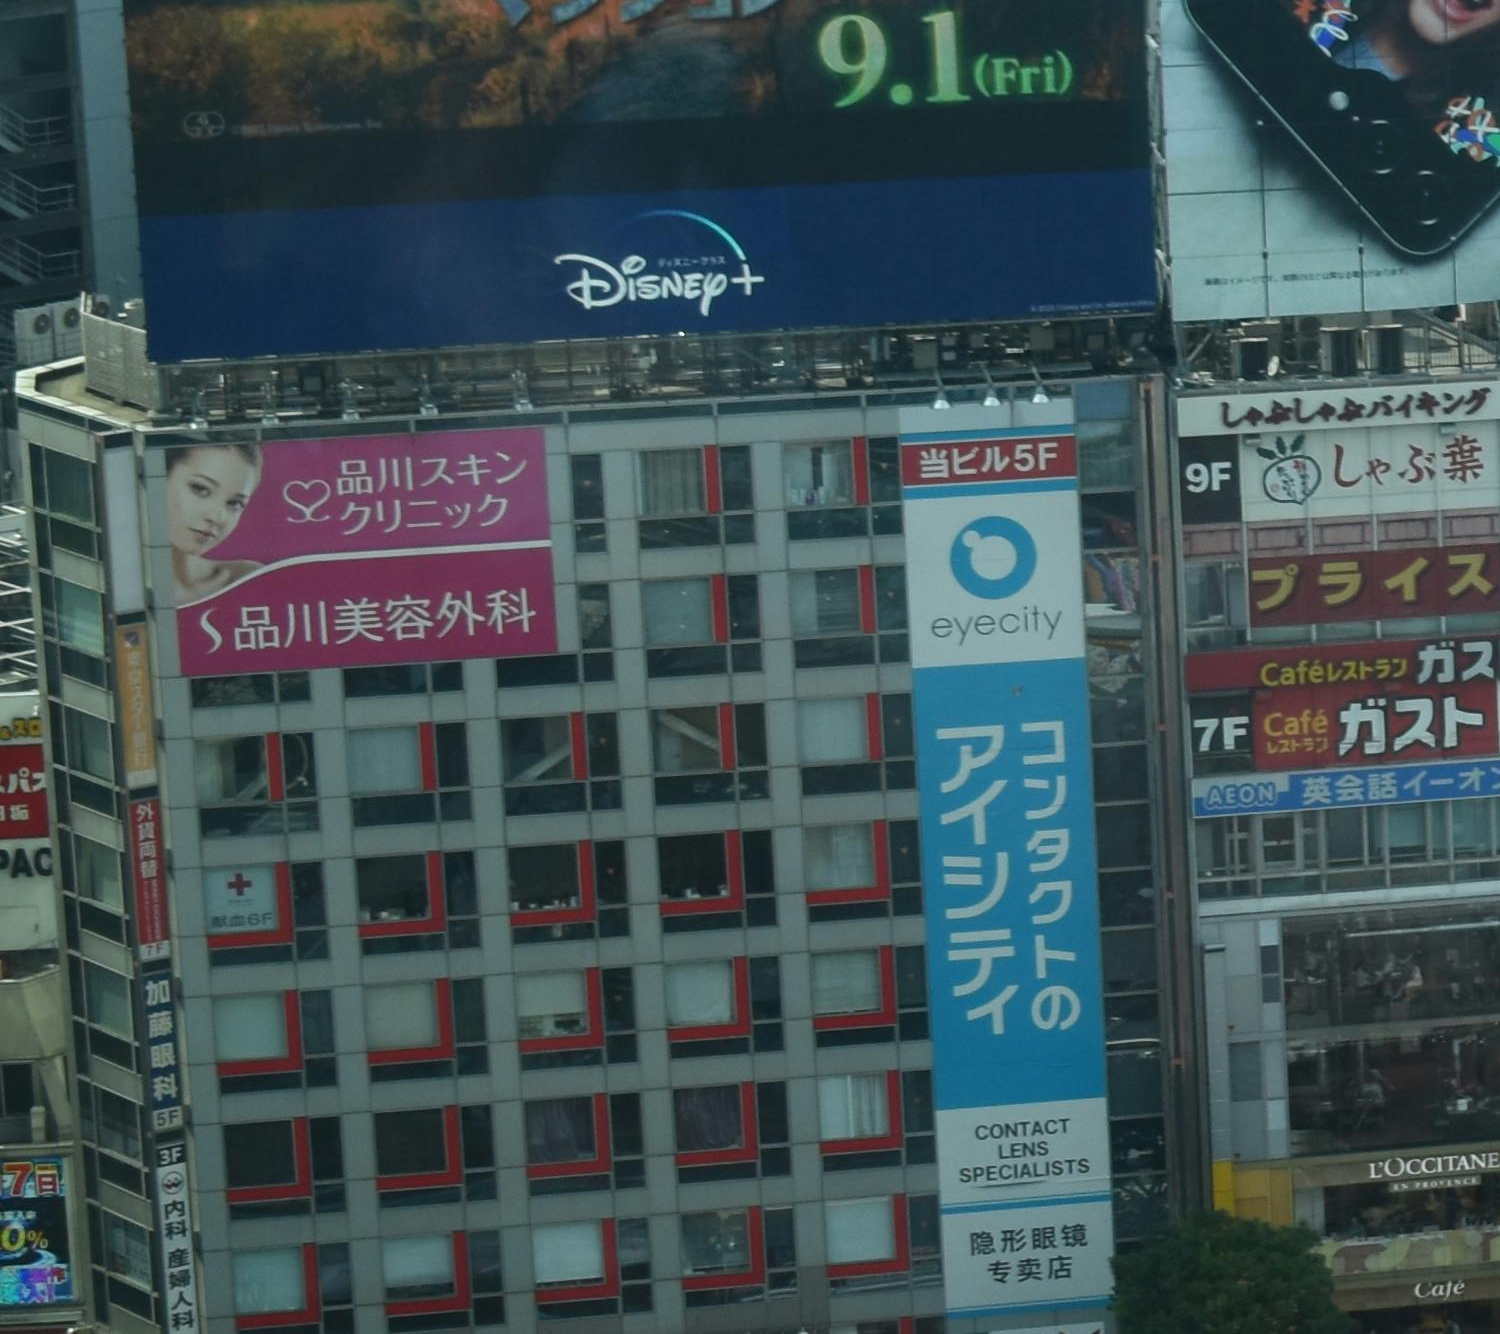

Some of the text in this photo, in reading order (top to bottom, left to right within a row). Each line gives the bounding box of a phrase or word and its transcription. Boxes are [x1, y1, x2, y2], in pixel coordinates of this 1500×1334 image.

[1220, 387, 1494, 430] しゃぶしゃぶバイキング
[335, 451, 529, 496] 品川スキン
[918, 442, 1059, 480] 当ビル5F
[1185, 460, 1232, 495] 9F
[1331, 433, 1485, 490] しゃぶ葉
[339, 493, 510, 536] クリニック
[1250, 550, 1497, 613] プライス
[232, 586, 537, 653] 品川美容外科
[930, 605, 1063, 647] eyecity
[1192, 716, 1250, 753] 7F
[1261, 705, 1329, 738] Café
[1336, 696, 1484, 758] ガスト
[1265, 734, 1330, 755] レストラン
[1205, 780, 1278, 810] AEON
[934, 723, 1019, 1036] アイシティ
[1020, 719, 1082, 1032] コンタクトの
[146, 979, 178, 1101] 加藤眼科
[974, 1117, 1072, 1141] CONTACT
[158, 1147, 182, 1165] 3F
[998, 1139, 1050, 1160] LENS
[1368, 1150, 1500, 1181] L'OCCITANE
[958, 1157, 1091, 1185] SPECIALISTS
[1425, 1176, 1480, 1189] PROVENCE
[162, 1199, 188, 1240] 内科
[968, 1223, 1089, 1257] 隐形眼镜
[987, 1255, 1074, 1284] 专卖店
[1413, 1279, 1467, 1300] Café
